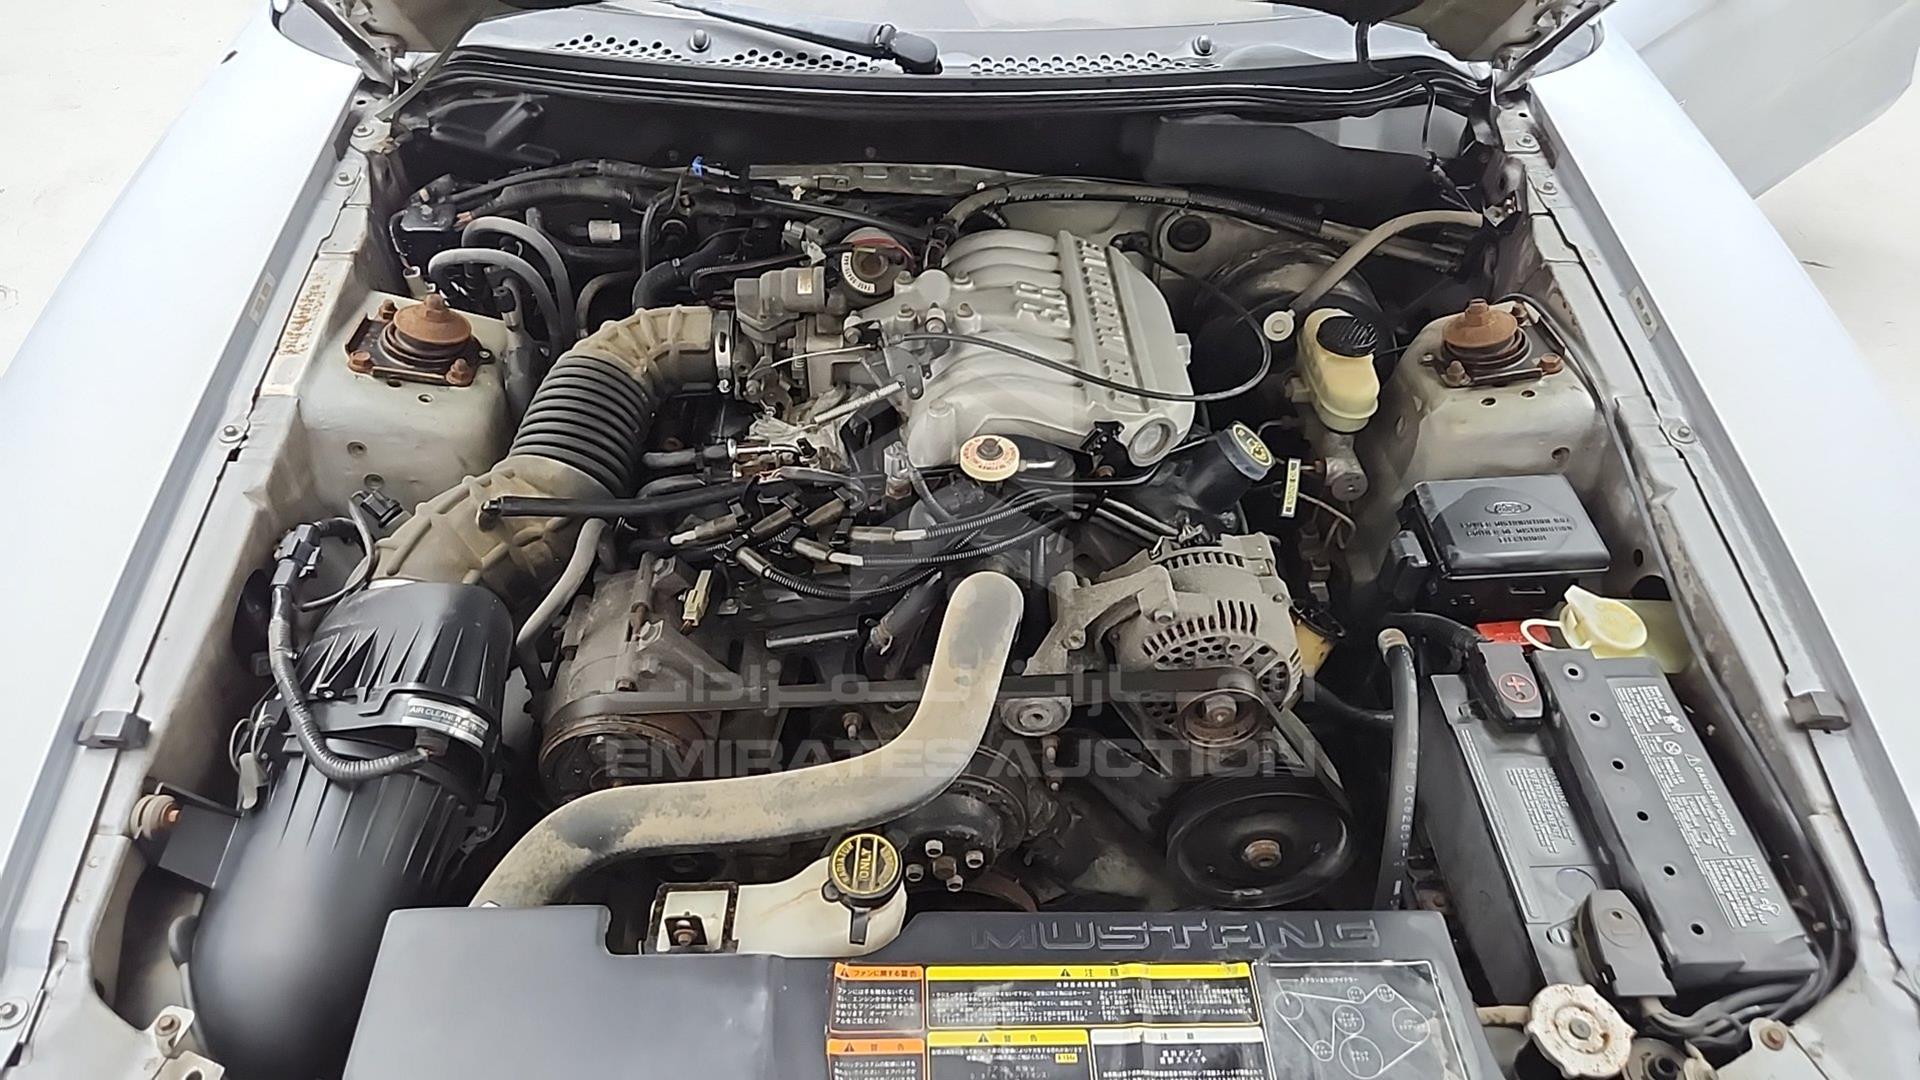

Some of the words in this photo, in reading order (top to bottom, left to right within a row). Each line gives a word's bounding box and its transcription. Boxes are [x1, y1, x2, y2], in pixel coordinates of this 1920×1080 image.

[409, 706, 424, 714] AIR
[425, 708, 461, 723] CLEANER
[1695, 766, 1737, 836] DANGER/POISON
[859, 847, 872, 880] ONLY
[970, 919, 1381, 949] MUSTANG
